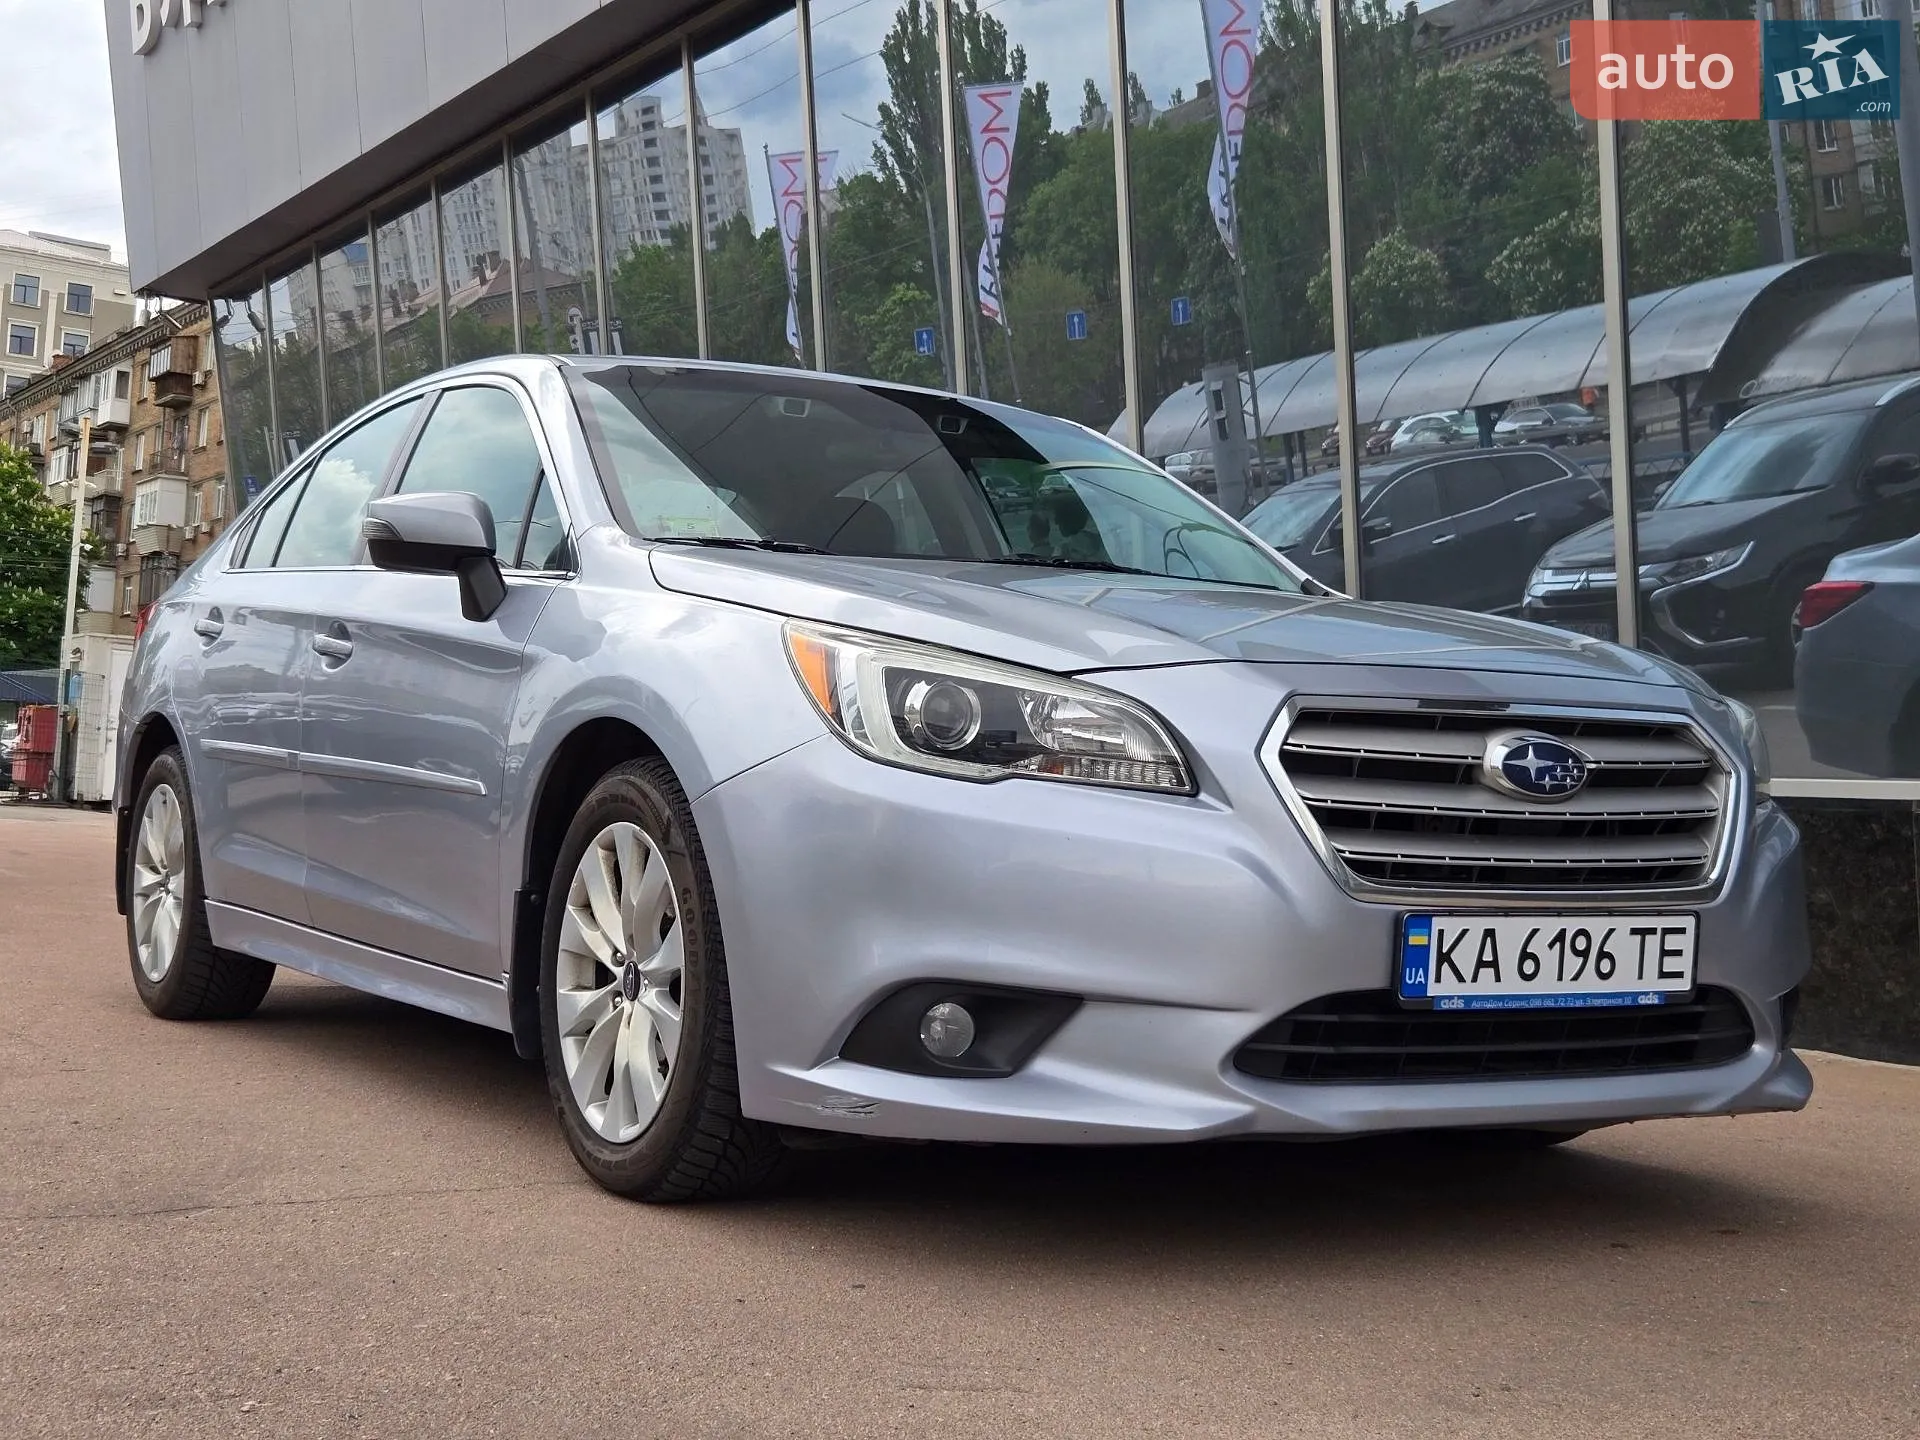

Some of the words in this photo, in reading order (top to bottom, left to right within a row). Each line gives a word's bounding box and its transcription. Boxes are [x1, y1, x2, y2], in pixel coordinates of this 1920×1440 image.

[1434, 928, 1501, 983] KA
[1517, 928, 1617, 981] 6196
[1629, 927, 1687, 979] TE
[1405, 968, 1426, 984] UA
[1440, 996, 1465, 1008] ads
[1638, 992, 1659, 1004] ads
